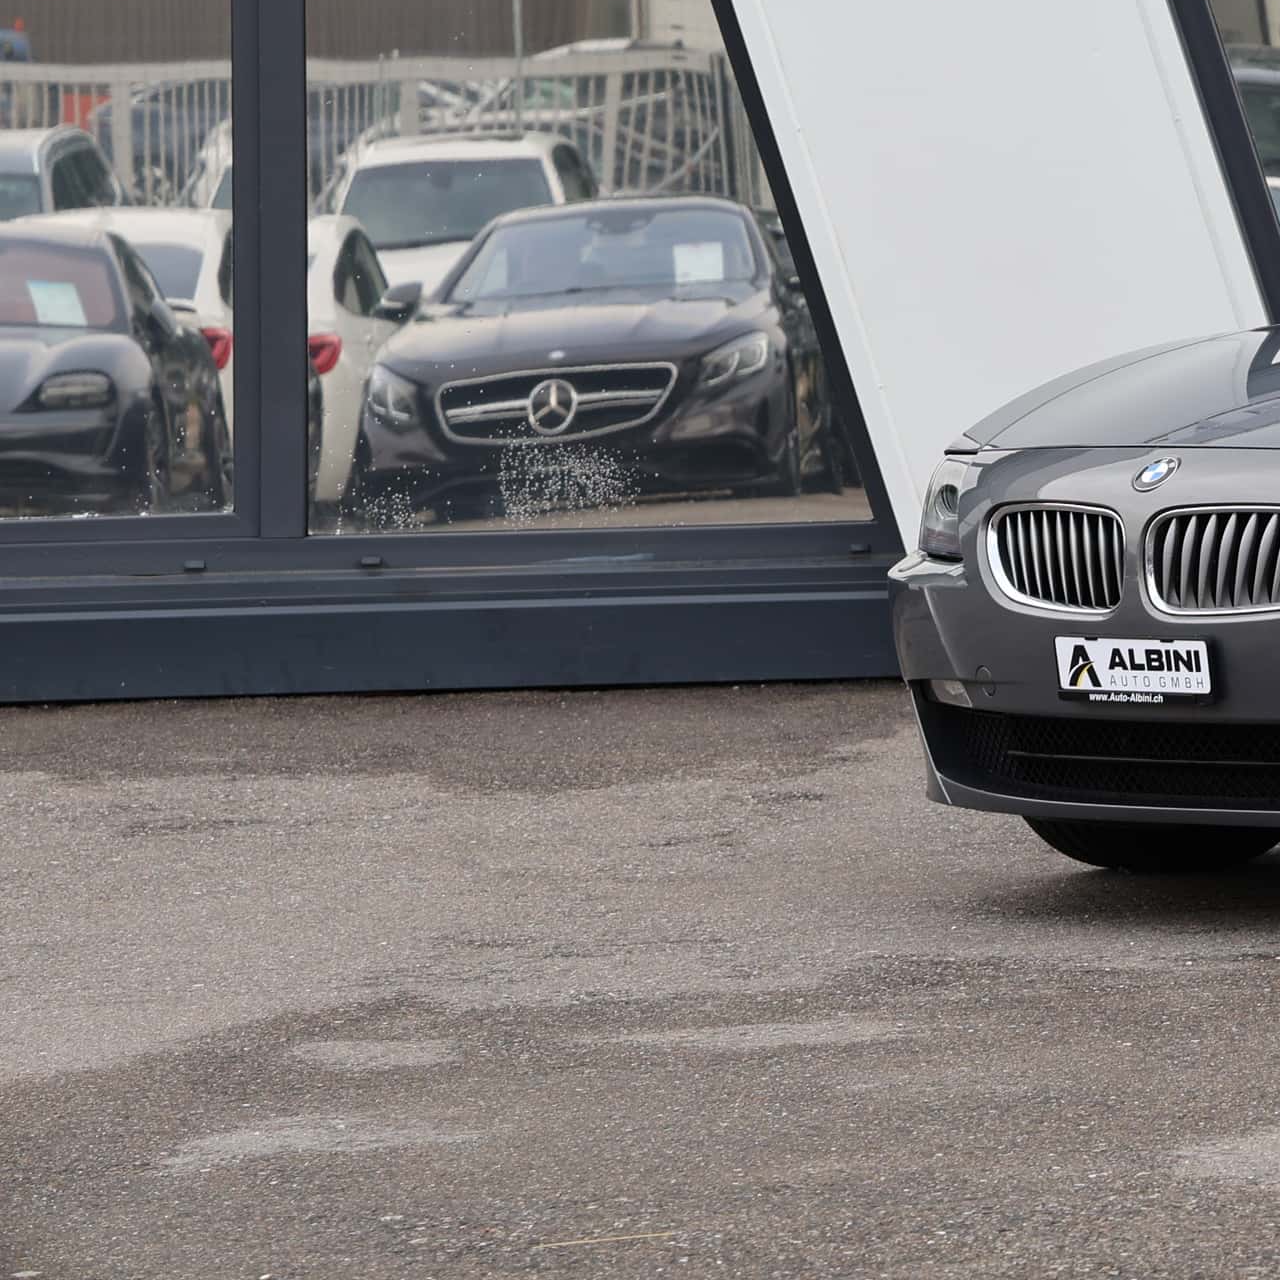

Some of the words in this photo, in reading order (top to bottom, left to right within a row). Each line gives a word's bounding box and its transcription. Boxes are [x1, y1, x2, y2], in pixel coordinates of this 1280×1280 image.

[1108, 647, 1202, 673] ALBINI
[1110, 675, 1150, 687] AUTO
[1159, 676, 1205, 689] GMBH
[1089, 692, 1164, 704] www.Auto-Albini.ch
